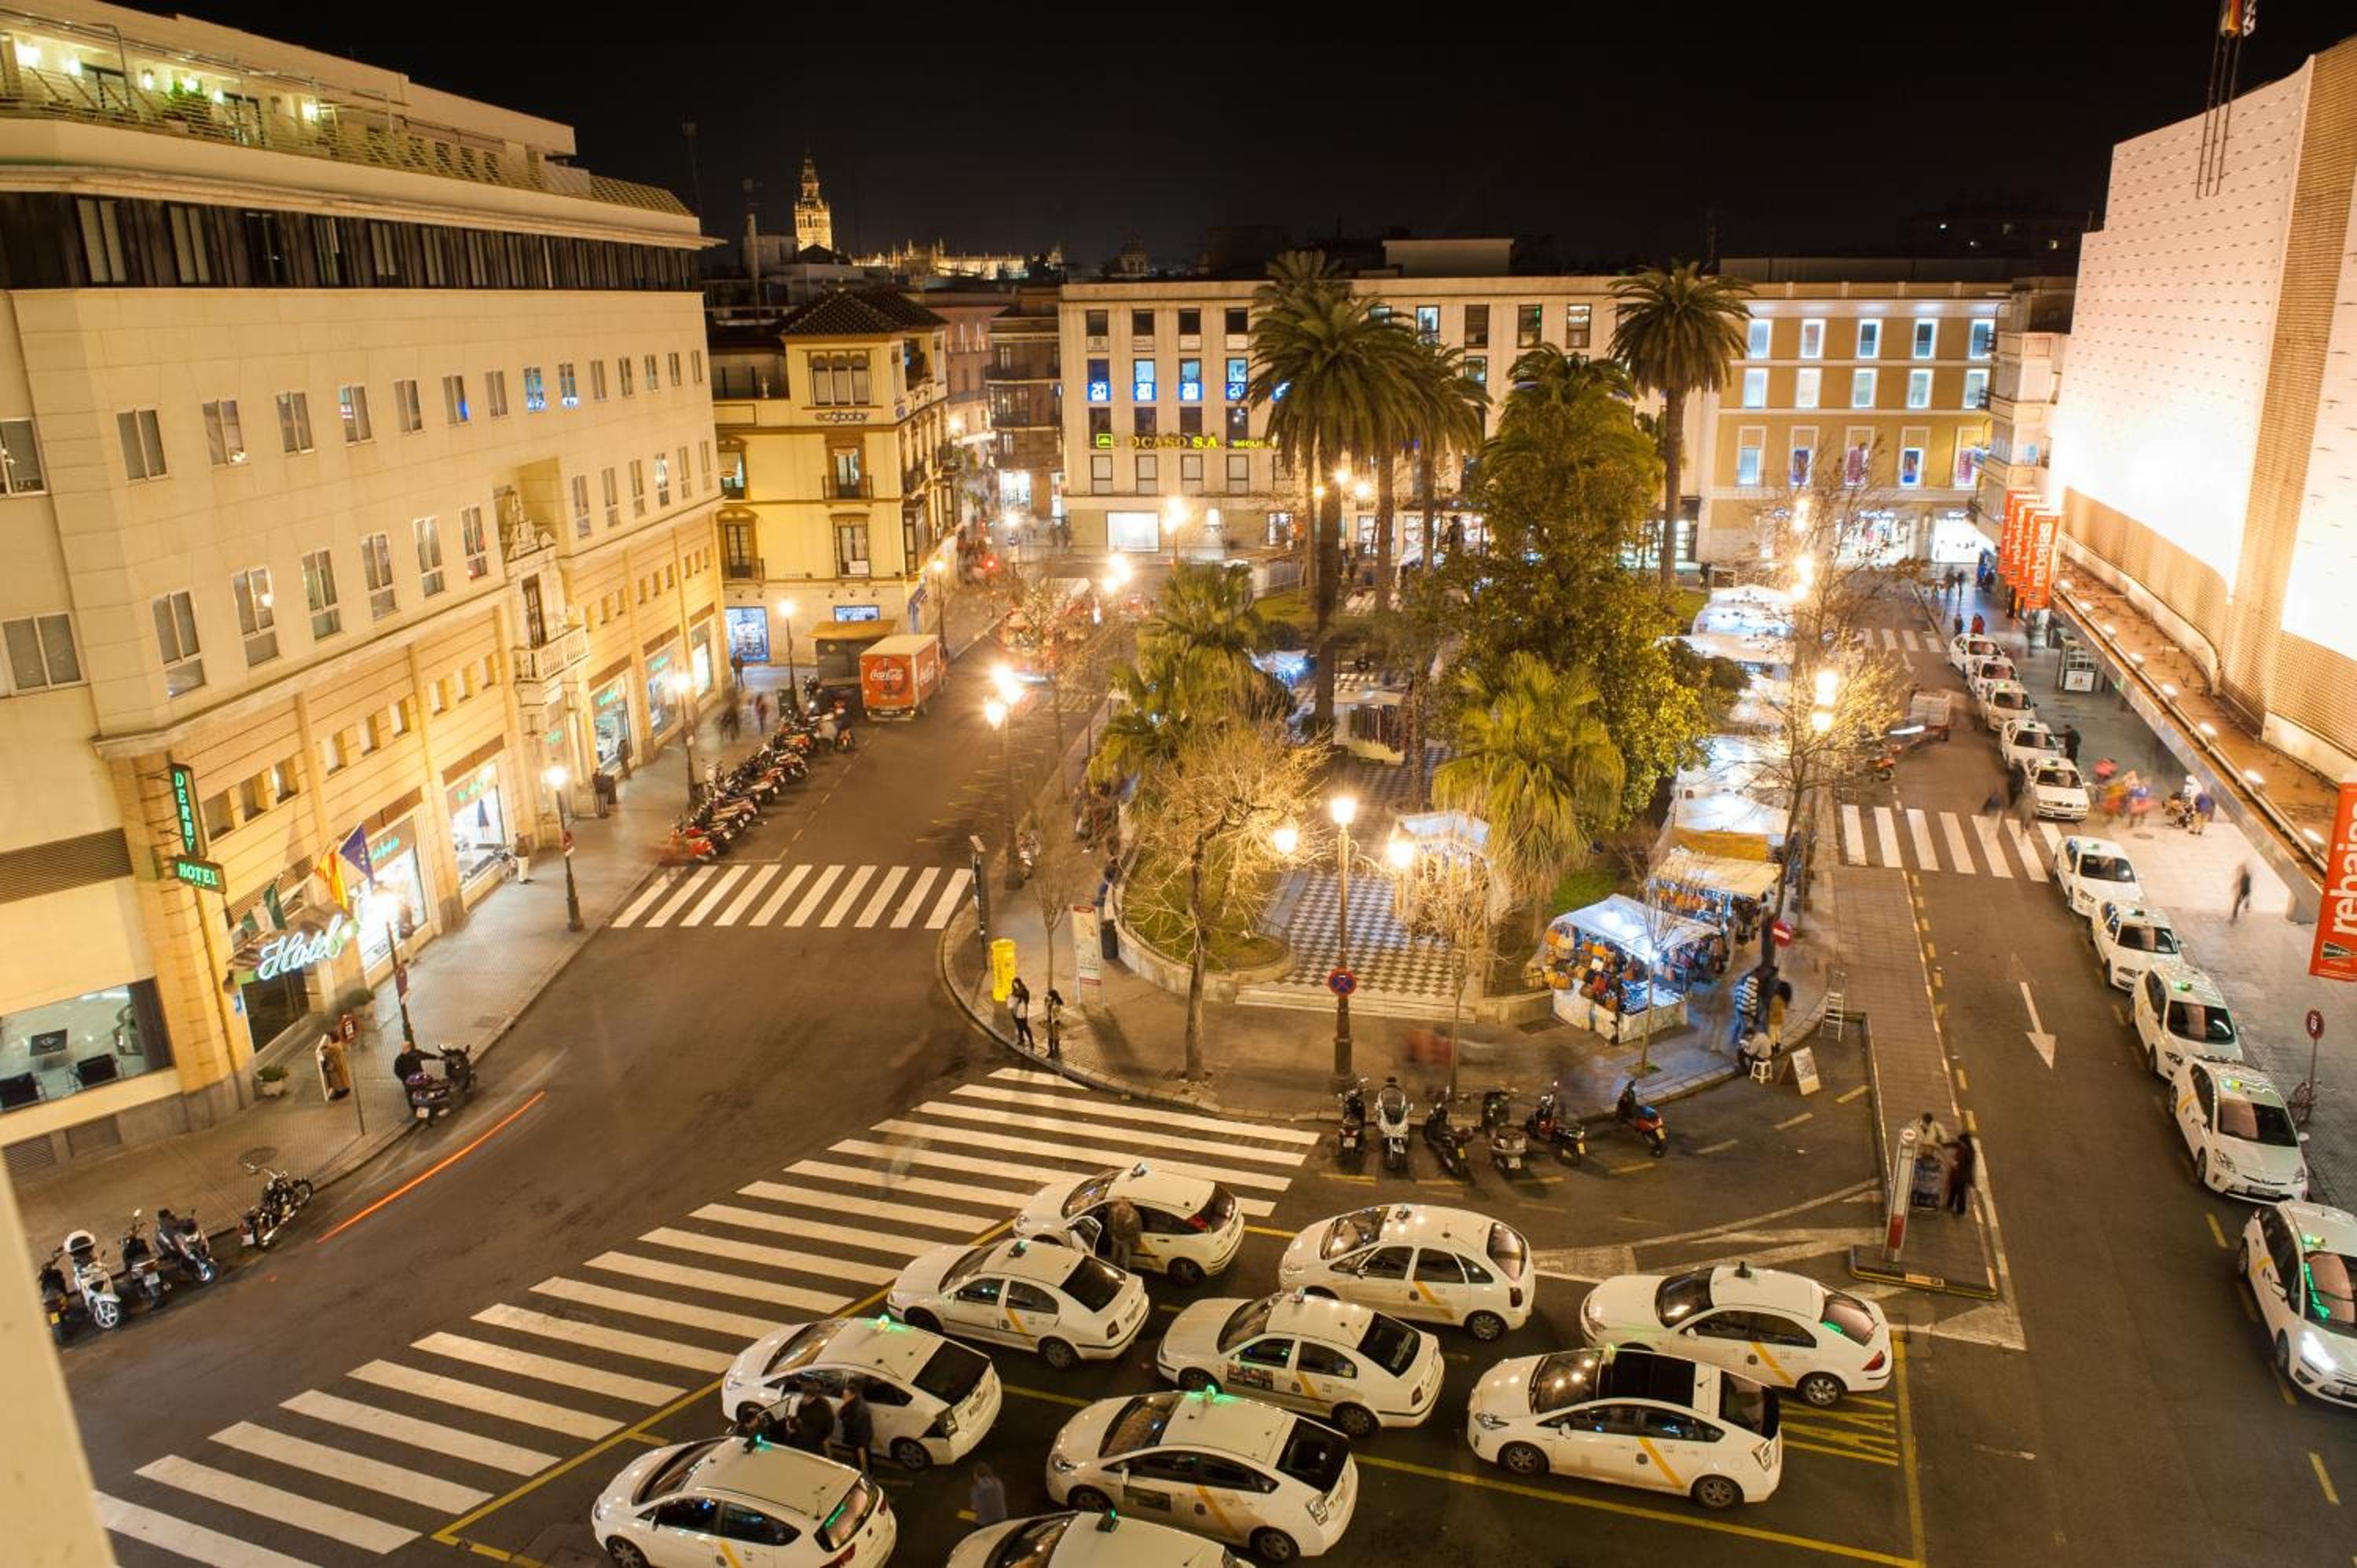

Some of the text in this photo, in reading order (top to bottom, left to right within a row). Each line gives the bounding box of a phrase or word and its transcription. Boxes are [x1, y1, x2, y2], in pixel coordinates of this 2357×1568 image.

[2031, 522, 2054, 587] rebajas
[175, 772, 195, 852] DERBY
[178, 863, 218, 885] HOTEL
[2330, 803, 2357, 936] rebaj
[258, 912, 343, 980] Hotel
